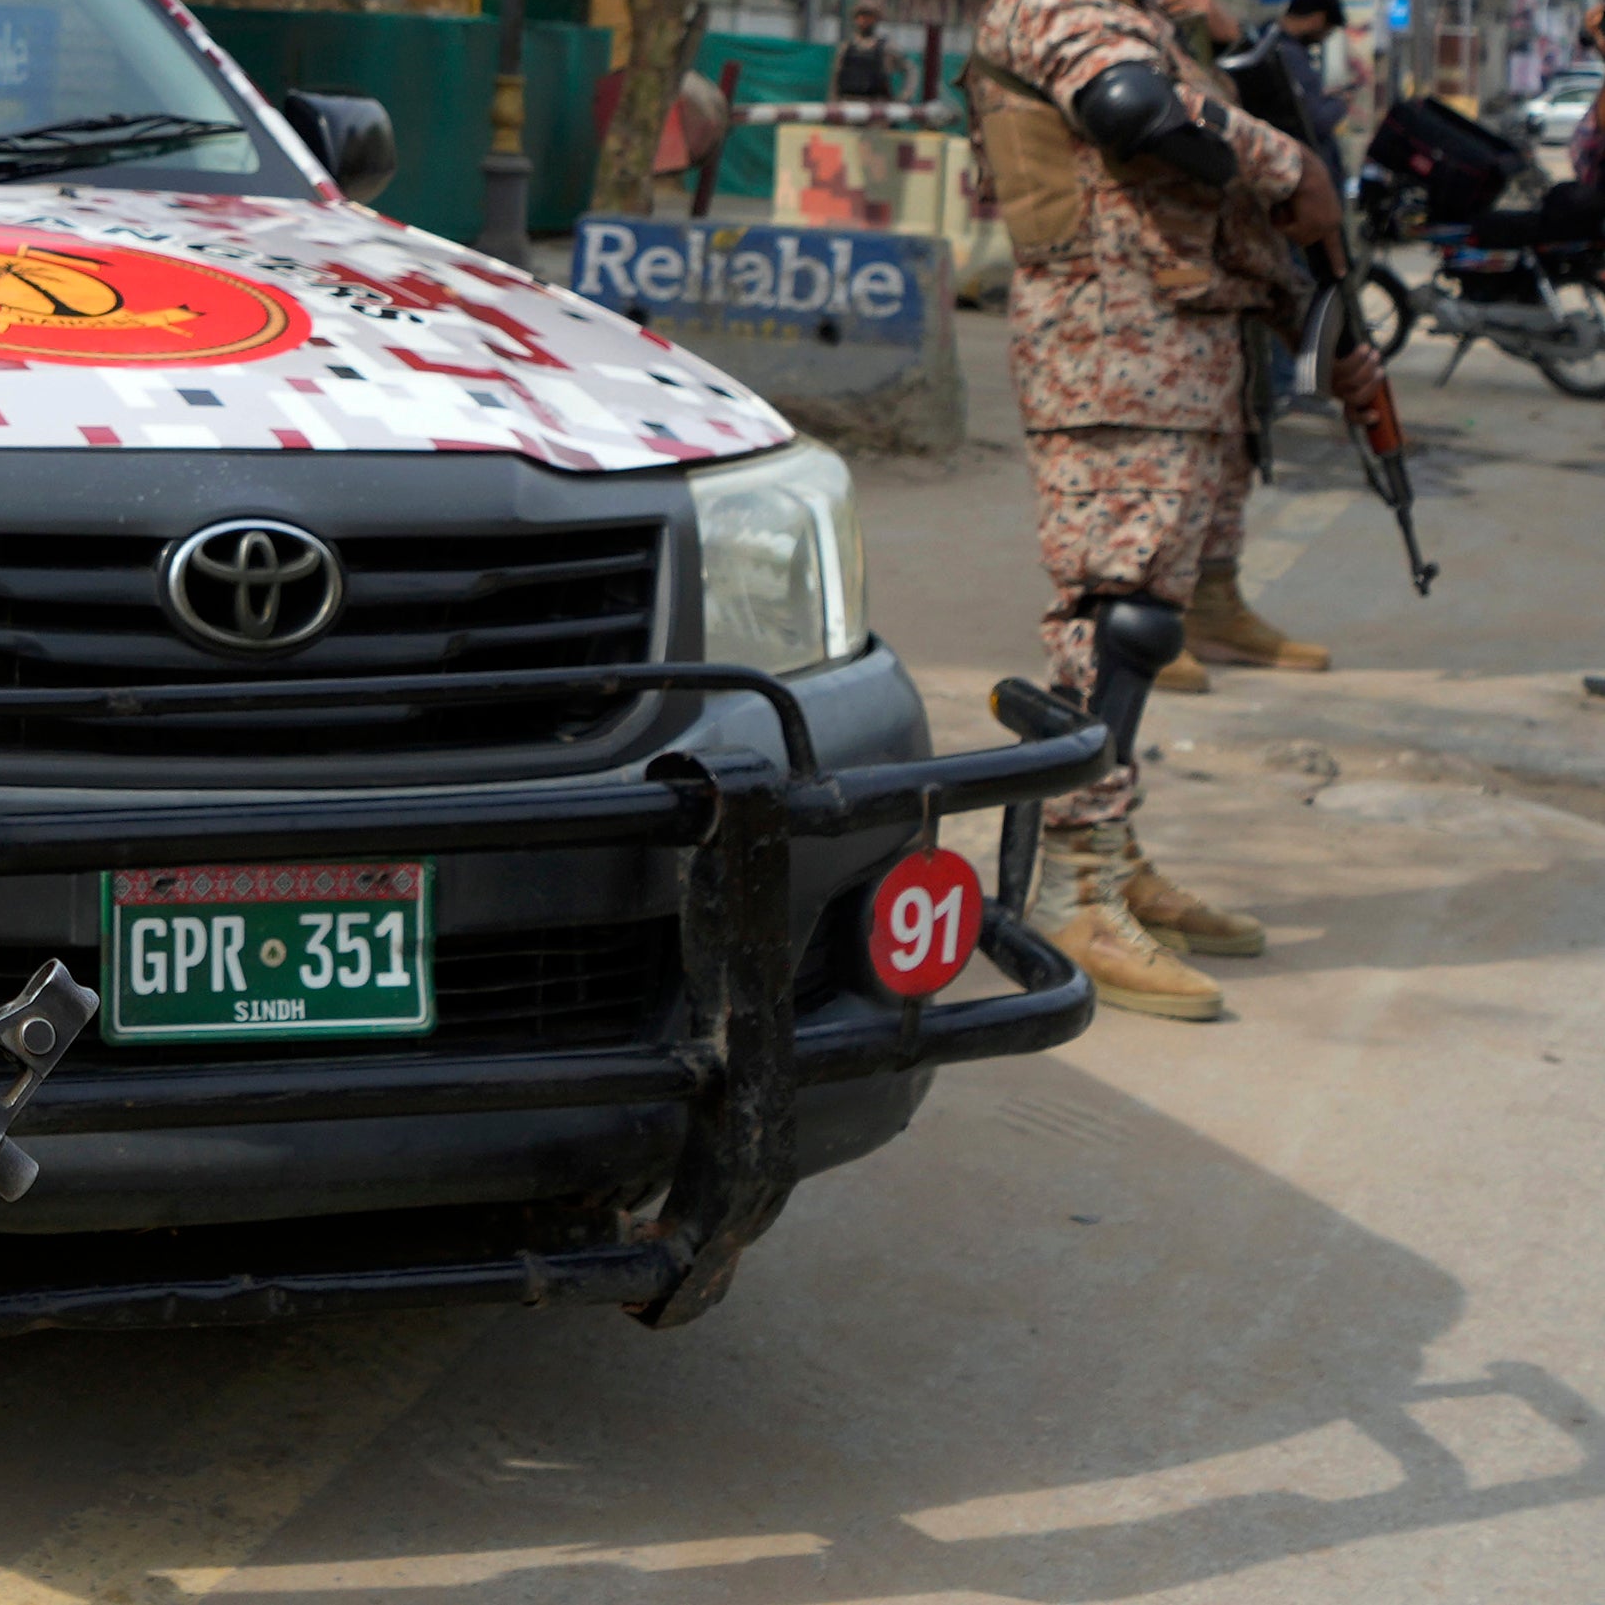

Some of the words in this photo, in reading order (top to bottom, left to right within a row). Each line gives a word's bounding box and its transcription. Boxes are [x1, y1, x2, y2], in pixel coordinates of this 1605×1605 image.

[577, 222, 906, 320] Reliable
[130, 915, 249, 996] GPR
[299, 910, 411, 990] 351
[889, 884, 965, 973] 91
[233, 997, 307, 1023] SINDH
